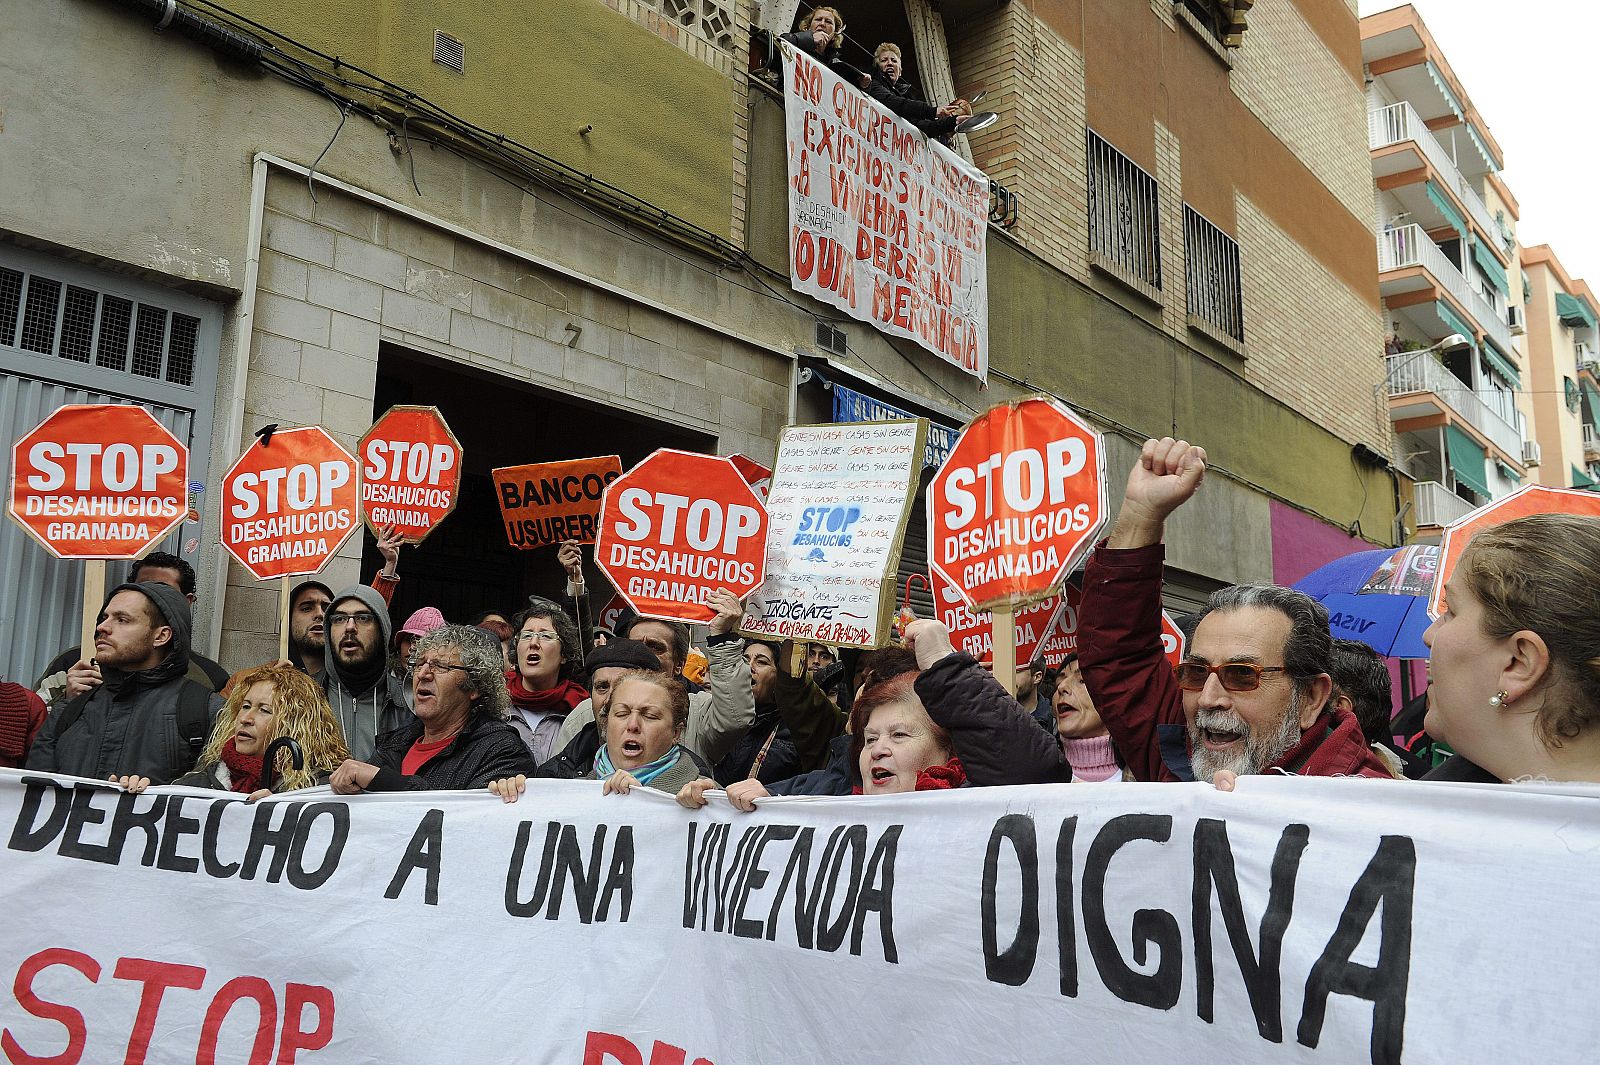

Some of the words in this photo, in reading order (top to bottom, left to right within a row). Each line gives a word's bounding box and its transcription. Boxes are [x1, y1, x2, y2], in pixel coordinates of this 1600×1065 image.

[794, 53, 822, 106] NO
[833, 82, 925, 173] QUEREMOS
[804, 111, 893, 193] EXIGIMOS
[856, 226, 953, 308] DERECHO
[565, 323, 582, 348] 7
[872, 274, 979, 372] MERCANCIA
[780, 447, 804, 457] CASAS
[848, 445, 874, 455] GENTE
[845, 430, 870, 440] CASAS
[888, 428, 913, 438] GENTE
[27, 441, 178, 492] STOP
[365, 439, 454, 485] STOP
[944, 436, 1087, 531] STOP
[26, 496, 178, 517] DESAHUCIOS
[231, 460, 351, 519] STOP
[362, 483, 451, 509] DESAHUCIOS
[47, 522, 150, 540] GRANADA
[231, 510, 350, 544] DESAHUCIOS
[371, 507, 431, 528] GRANADA
[615, 488, 761, 554] STOP
[799, 507, 861, 532] STOP
[944, 503, 1090, 565] DESAHUCIOS
[247, 538, 328, 564] GRANADA
[793, 534, 852, 547] DESAHUCIOS
[609, 544, 755, 586] DESAHUCIOS
[963, 545, 1060, 590] GRANADA
[628, 576, 714, 605] GRANAD
[8, 776, 349, 890] DERECHO
[384, 808, 442, 905] A
[504, 821, 633, 924] UNA
[682, 821, 903, 964] VIVIENDA
[981, 812, 1415, 1065] DIGNA
[1, 947, 335, 1065] STOP
